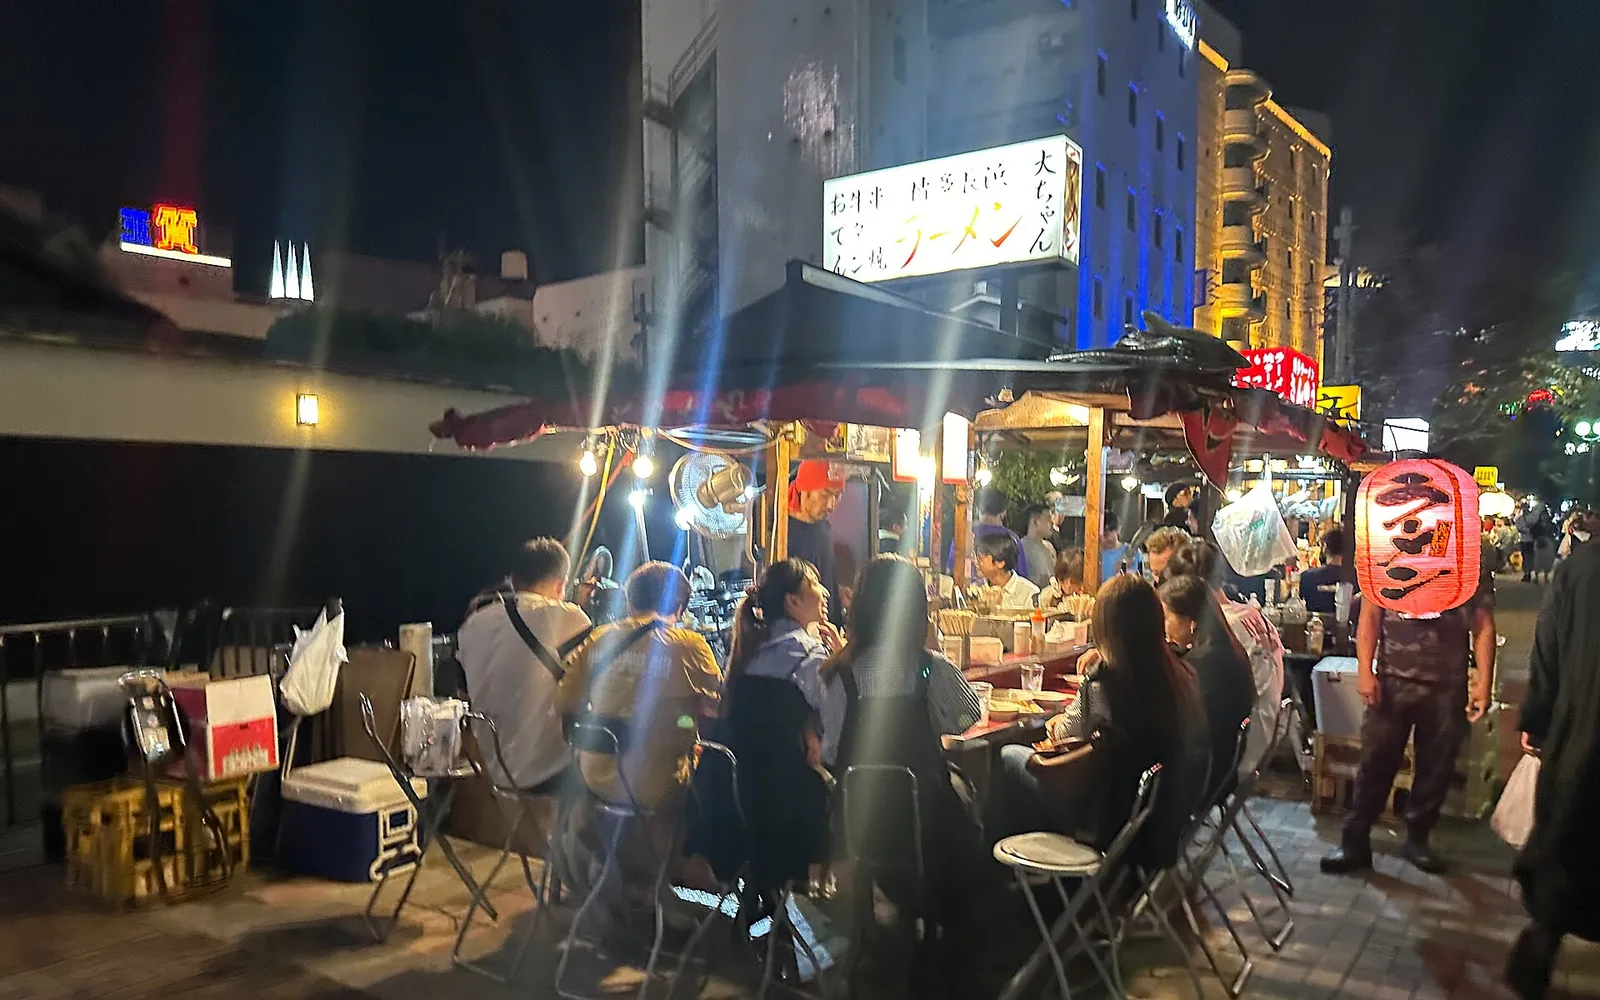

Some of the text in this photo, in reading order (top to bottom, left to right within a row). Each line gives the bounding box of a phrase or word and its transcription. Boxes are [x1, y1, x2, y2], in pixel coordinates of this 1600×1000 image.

[896, 202, 1023, 270] ラーメン
[1029, 149, 1056, 254] 大ちゃん
